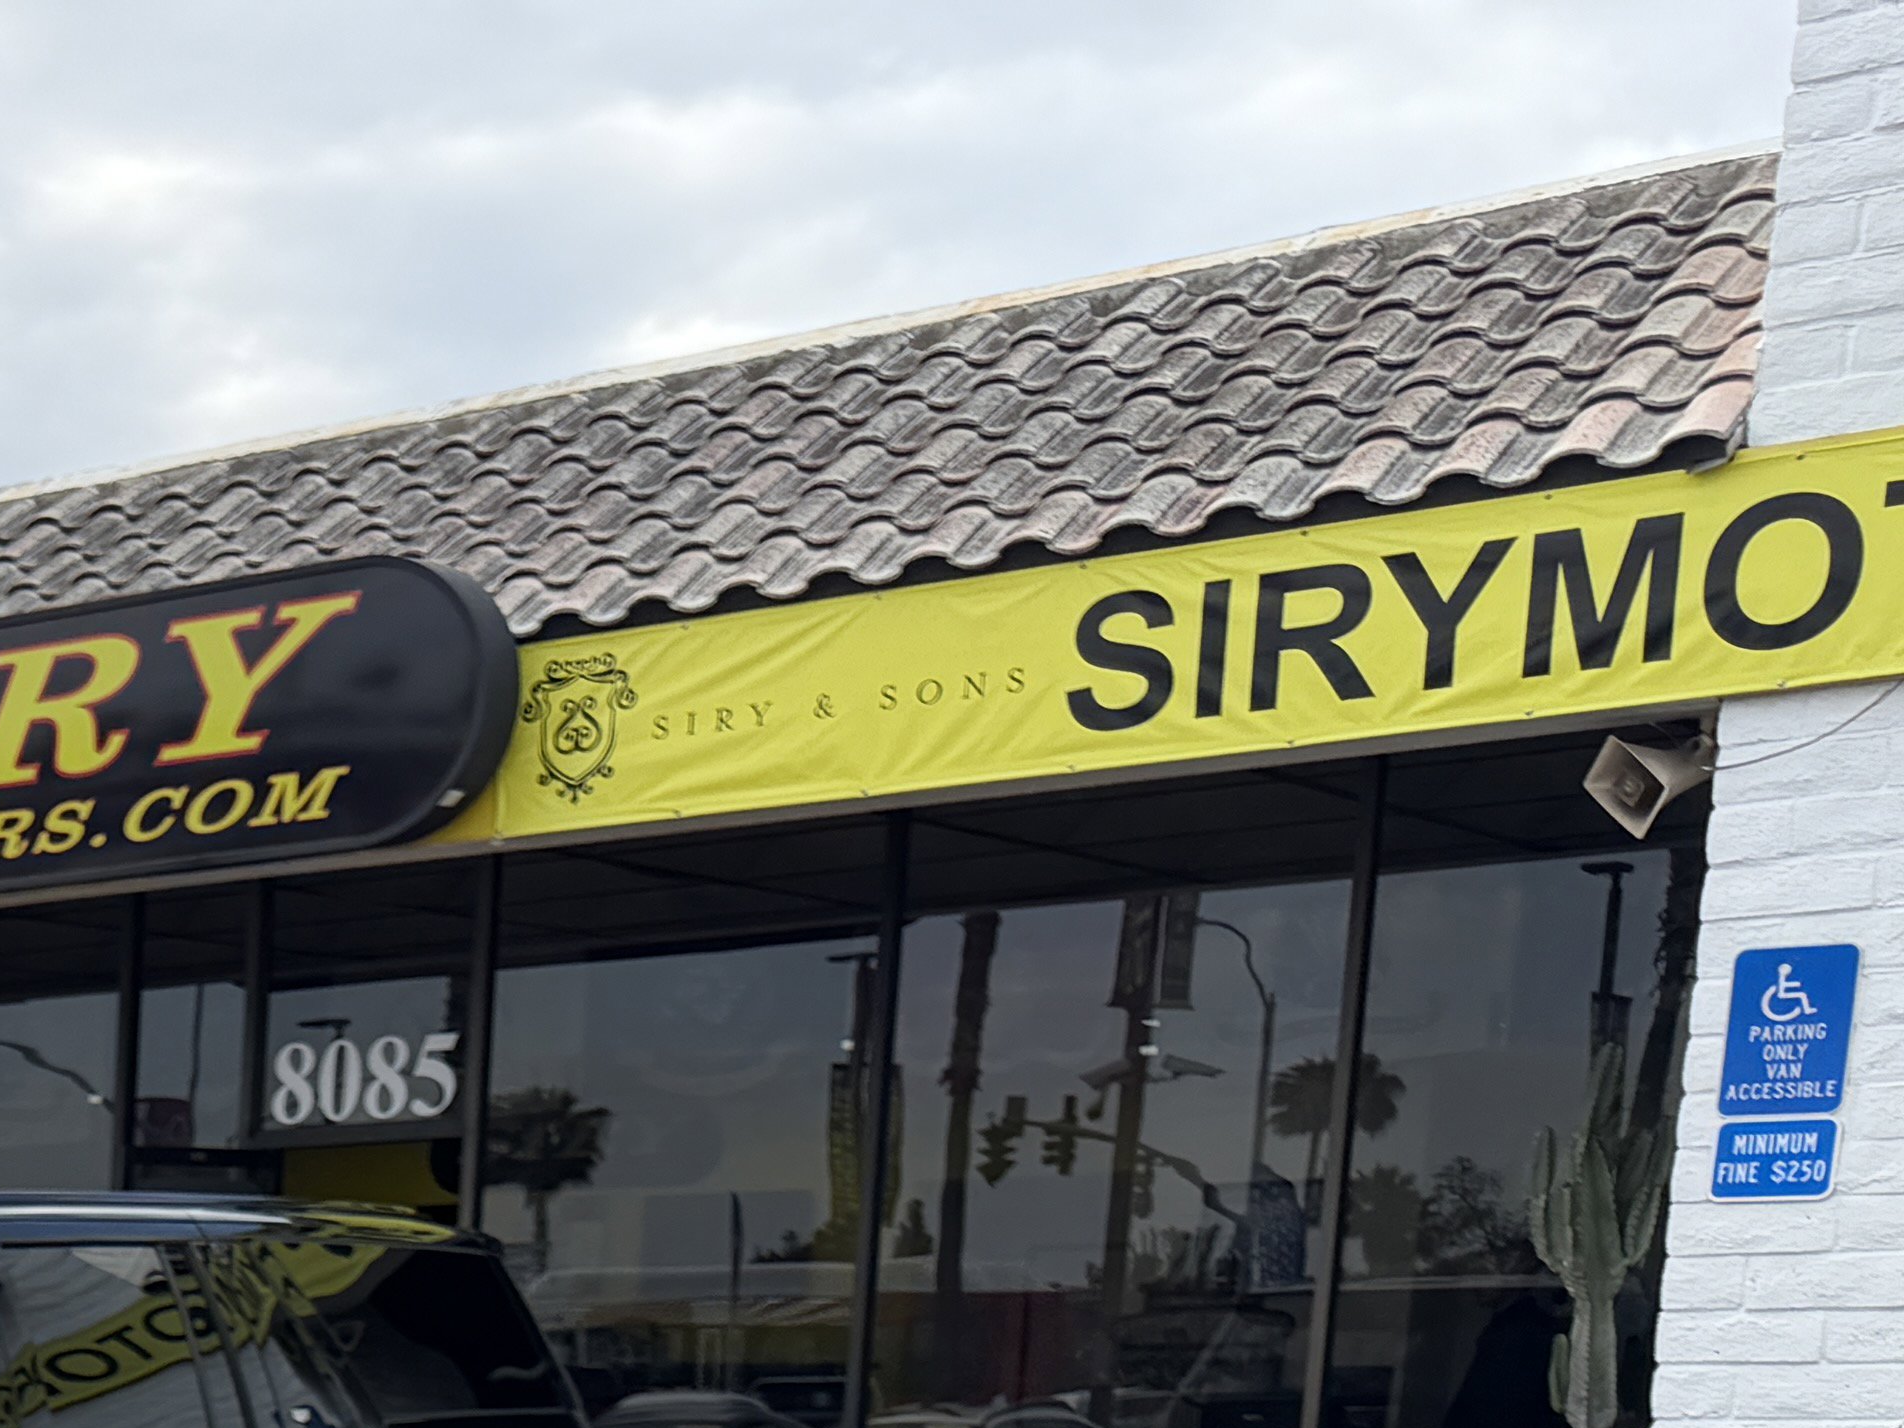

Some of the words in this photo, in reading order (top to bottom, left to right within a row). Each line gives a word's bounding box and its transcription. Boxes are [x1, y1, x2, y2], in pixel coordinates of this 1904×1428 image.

[1066, 480, 1904, 732] SIRYMO
[652, 701, 772, 740] SIRY
[813, 692, 837, 719] &
[879, 667, 1028, 711] SONS
[1748, 1023, 1827, 1043] PARKING
[1762, 1043, 1809, 1061] ONLY
[271, 1031, 460, 1125] 8085
[1766, 1063, 1802, 1079] VAN
[1725, 1080, 1838, 1101] ACCESSIBLE
[1733, 1132, 1819, 1155] MINIMUM
[1717, 1162, 1760, 1184] FINE
[1770, 1161, 1827, 1184] $250
